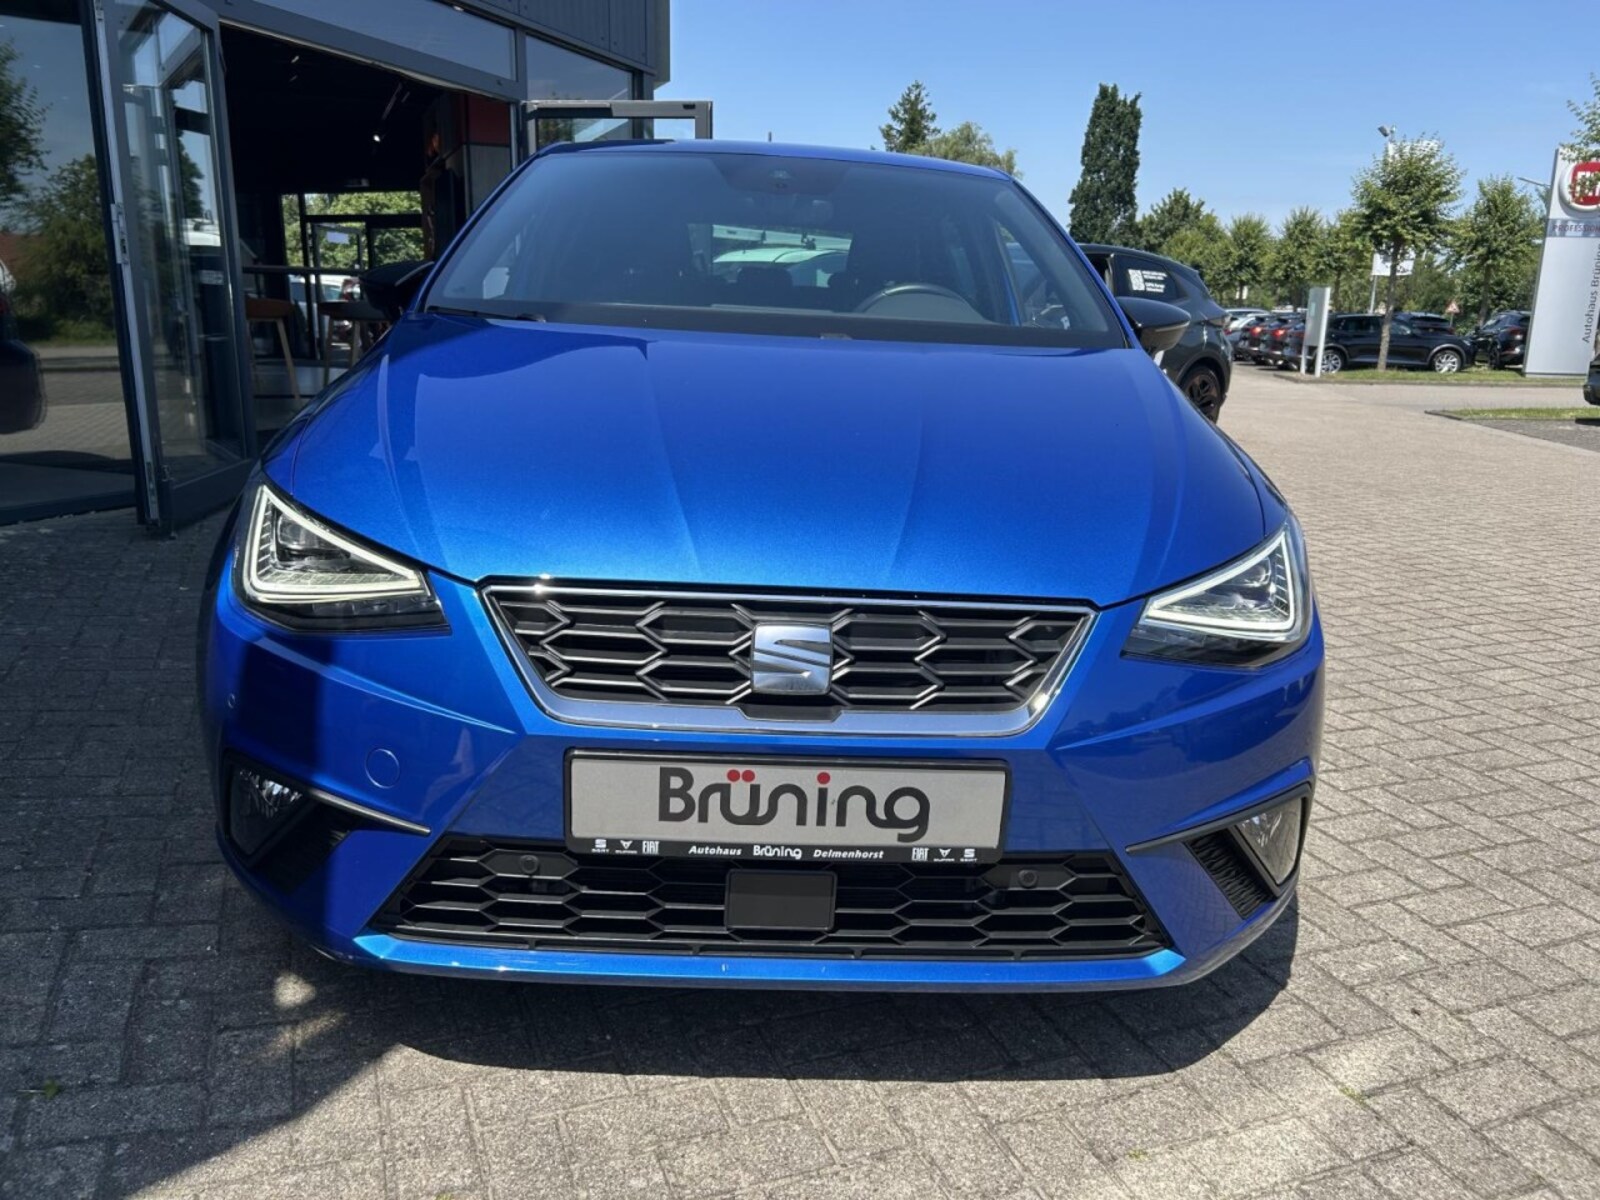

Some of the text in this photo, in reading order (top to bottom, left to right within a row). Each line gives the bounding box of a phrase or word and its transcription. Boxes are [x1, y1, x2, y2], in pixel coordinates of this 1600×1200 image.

[658, 766, 931, 843] Brüning
[688, 845, 884, 860] Autohaus Brüning Delmenhorst
